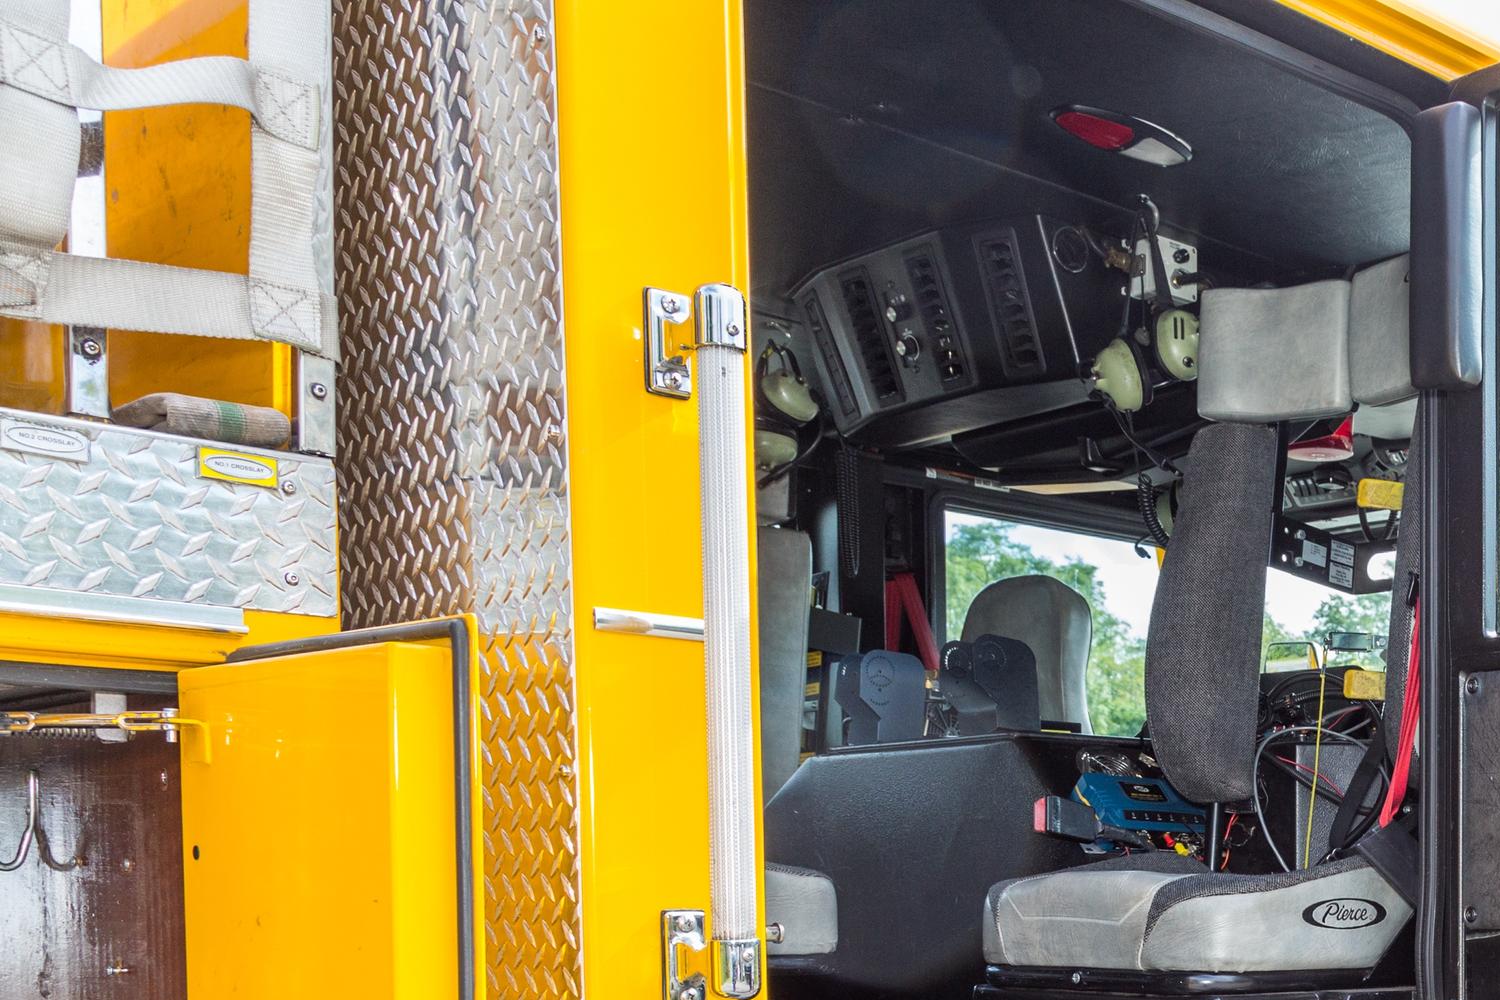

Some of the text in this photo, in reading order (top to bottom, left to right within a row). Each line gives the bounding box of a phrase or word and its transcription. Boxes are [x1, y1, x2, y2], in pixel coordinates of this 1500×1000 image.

[37, 435, 75, 446] CROSSLAY
[230, 463, 264, 473] CROSSLAY
[1321, 902, 1368, 924] Pierce
